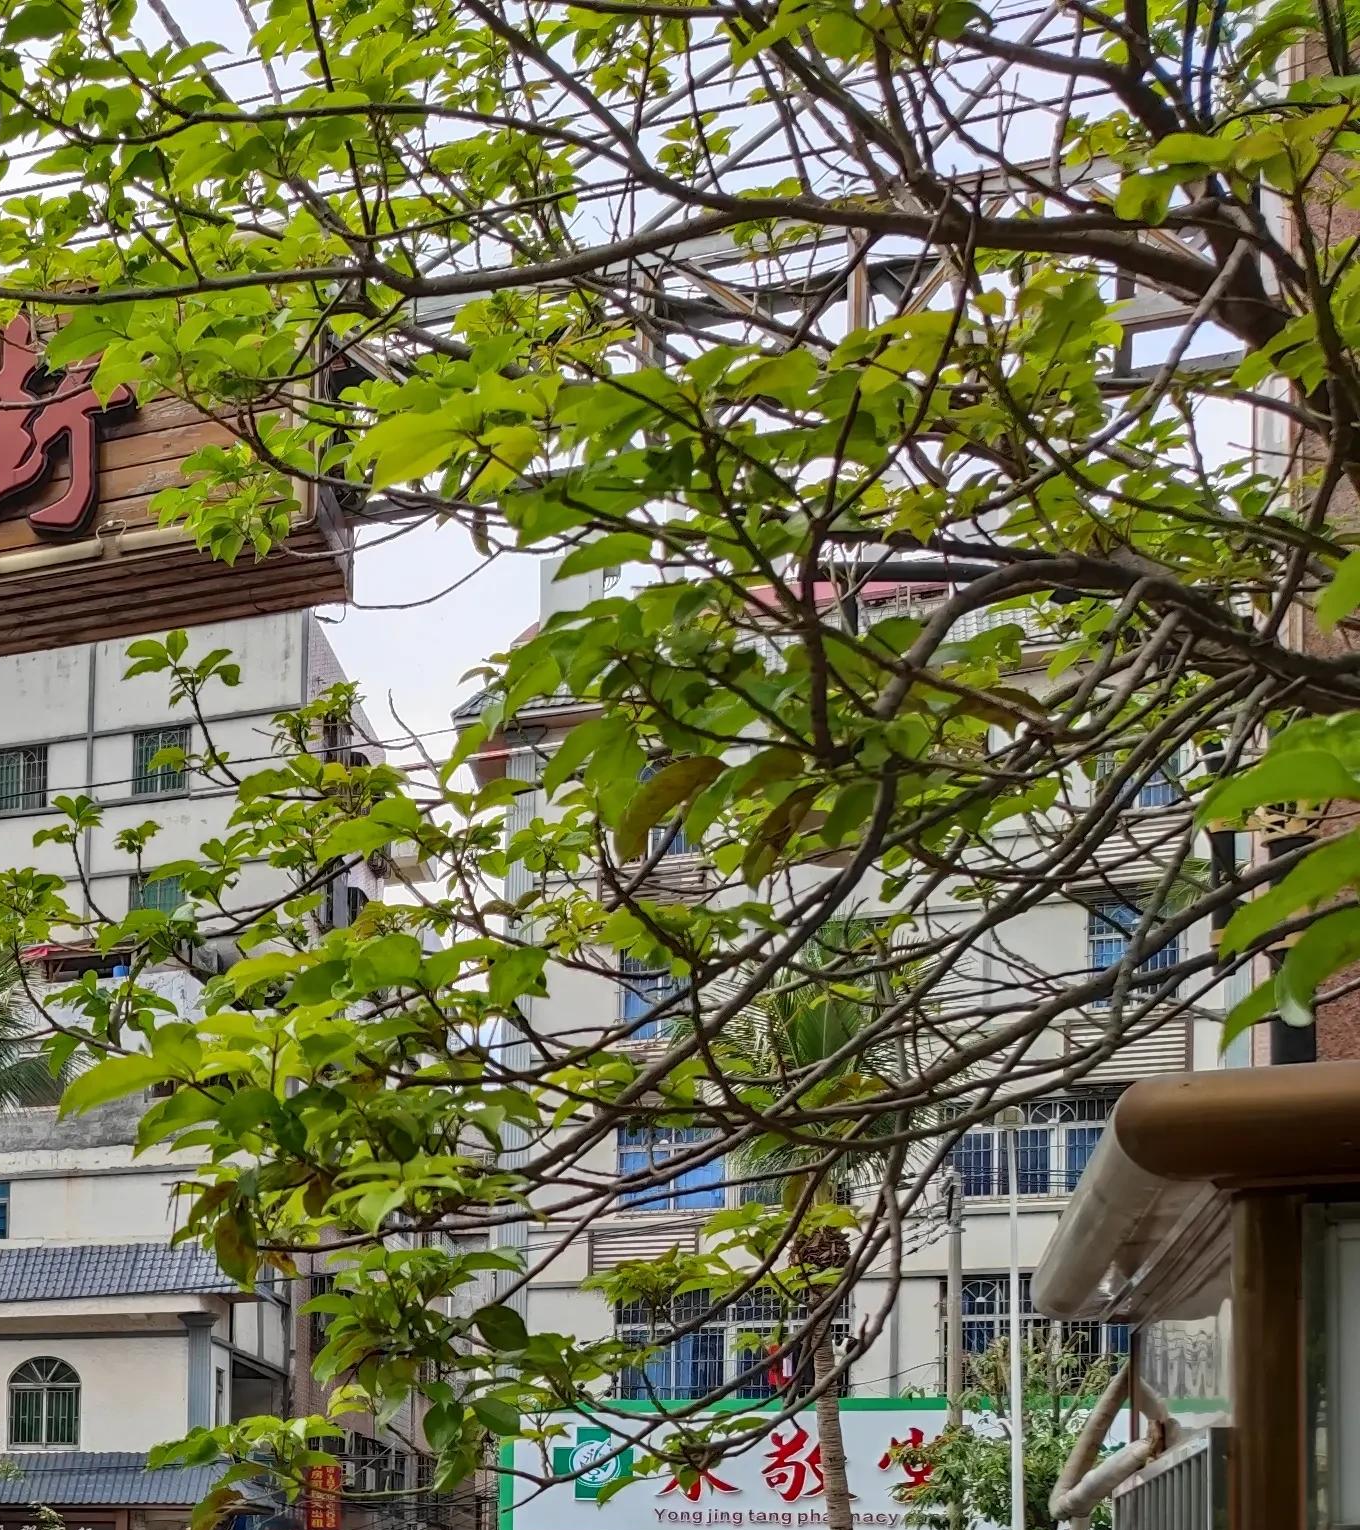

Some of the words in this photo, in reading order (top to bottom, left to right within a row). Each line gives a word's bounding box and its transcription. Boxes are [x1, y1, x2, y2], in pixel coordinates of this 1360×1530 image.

[654, 1508, 703, 1524] Yong
[705, 1509, 743, 1525] jing
[748, 1509, 791, 1526] tang
[797, 1509, 899, 1526] phamacy
